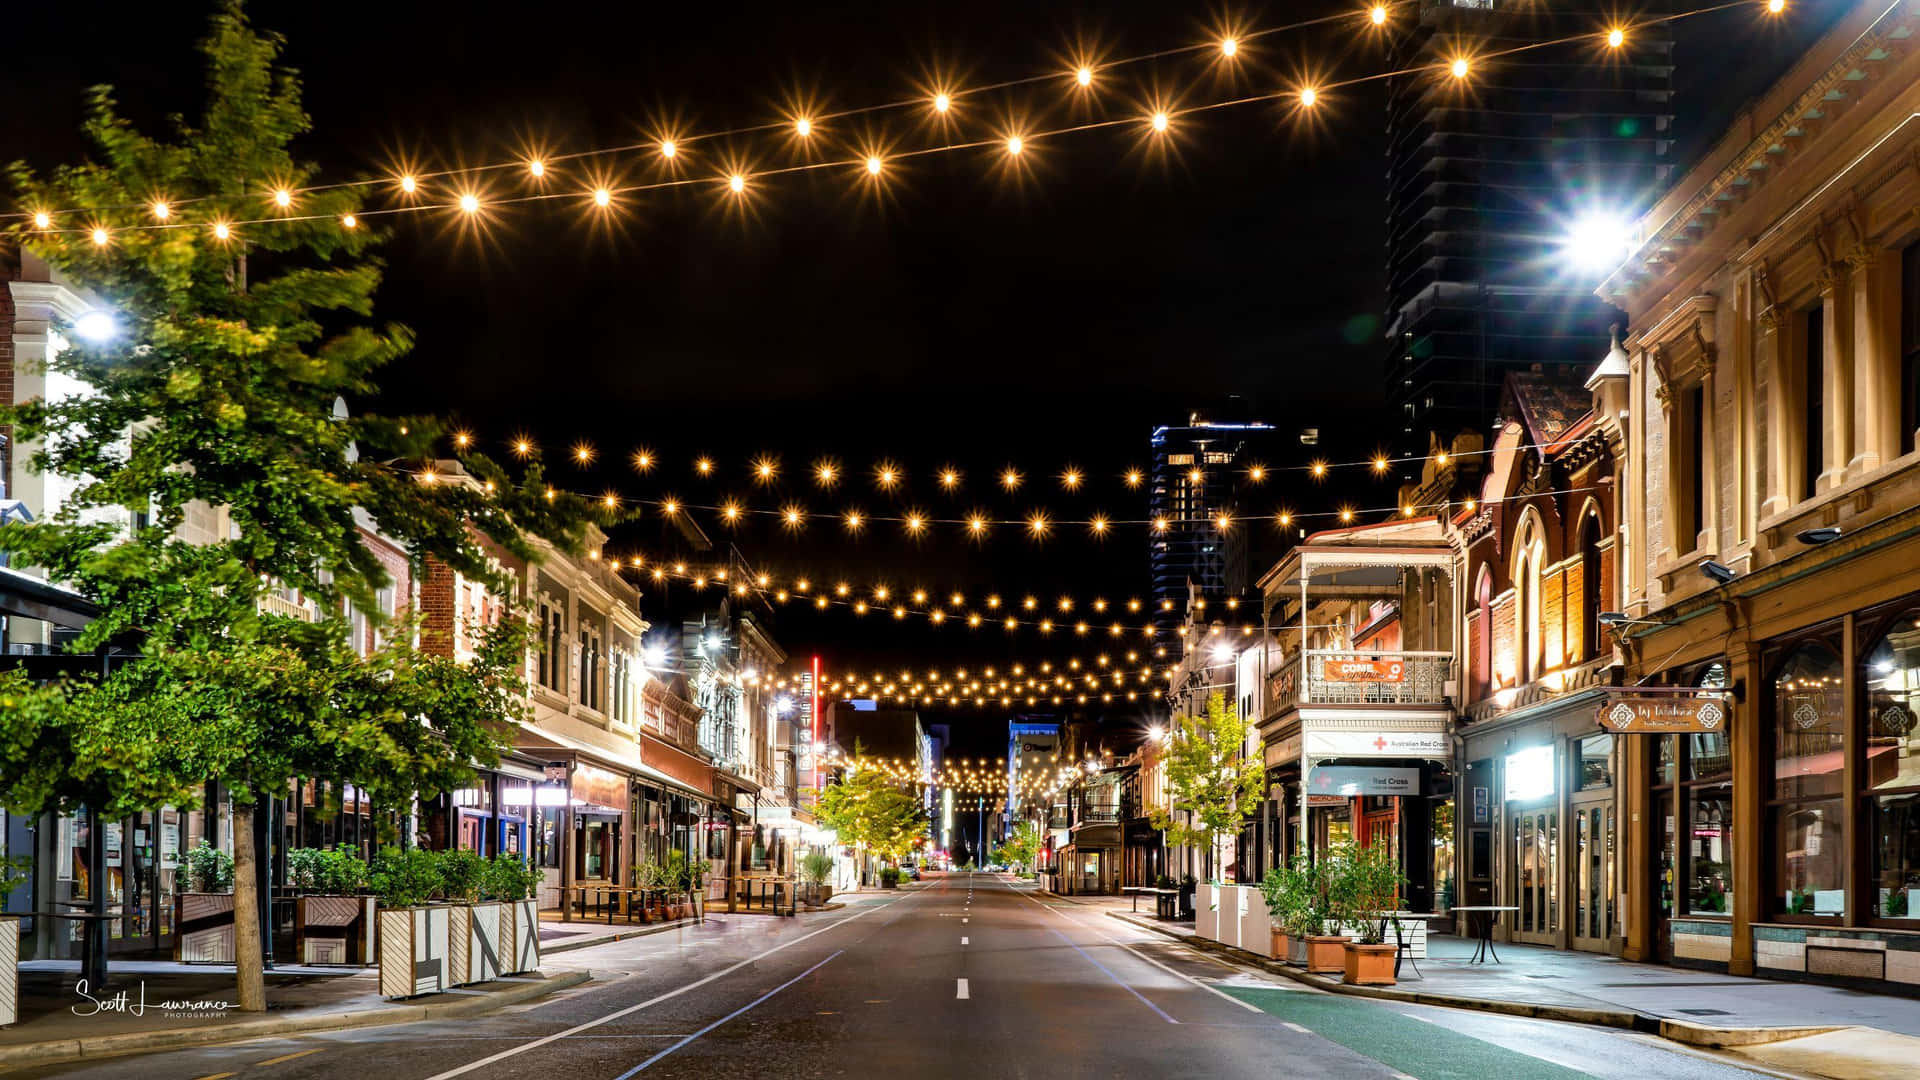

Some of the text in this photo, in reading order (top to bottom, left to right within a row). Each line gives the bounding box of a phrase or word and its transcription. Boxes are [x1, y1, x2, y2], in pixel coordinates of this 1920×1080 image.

[1342, 663, 1375, 673] COME
[1372, 777, 1387, 785] Red
[1387, 777, 1409, 785] Cross
